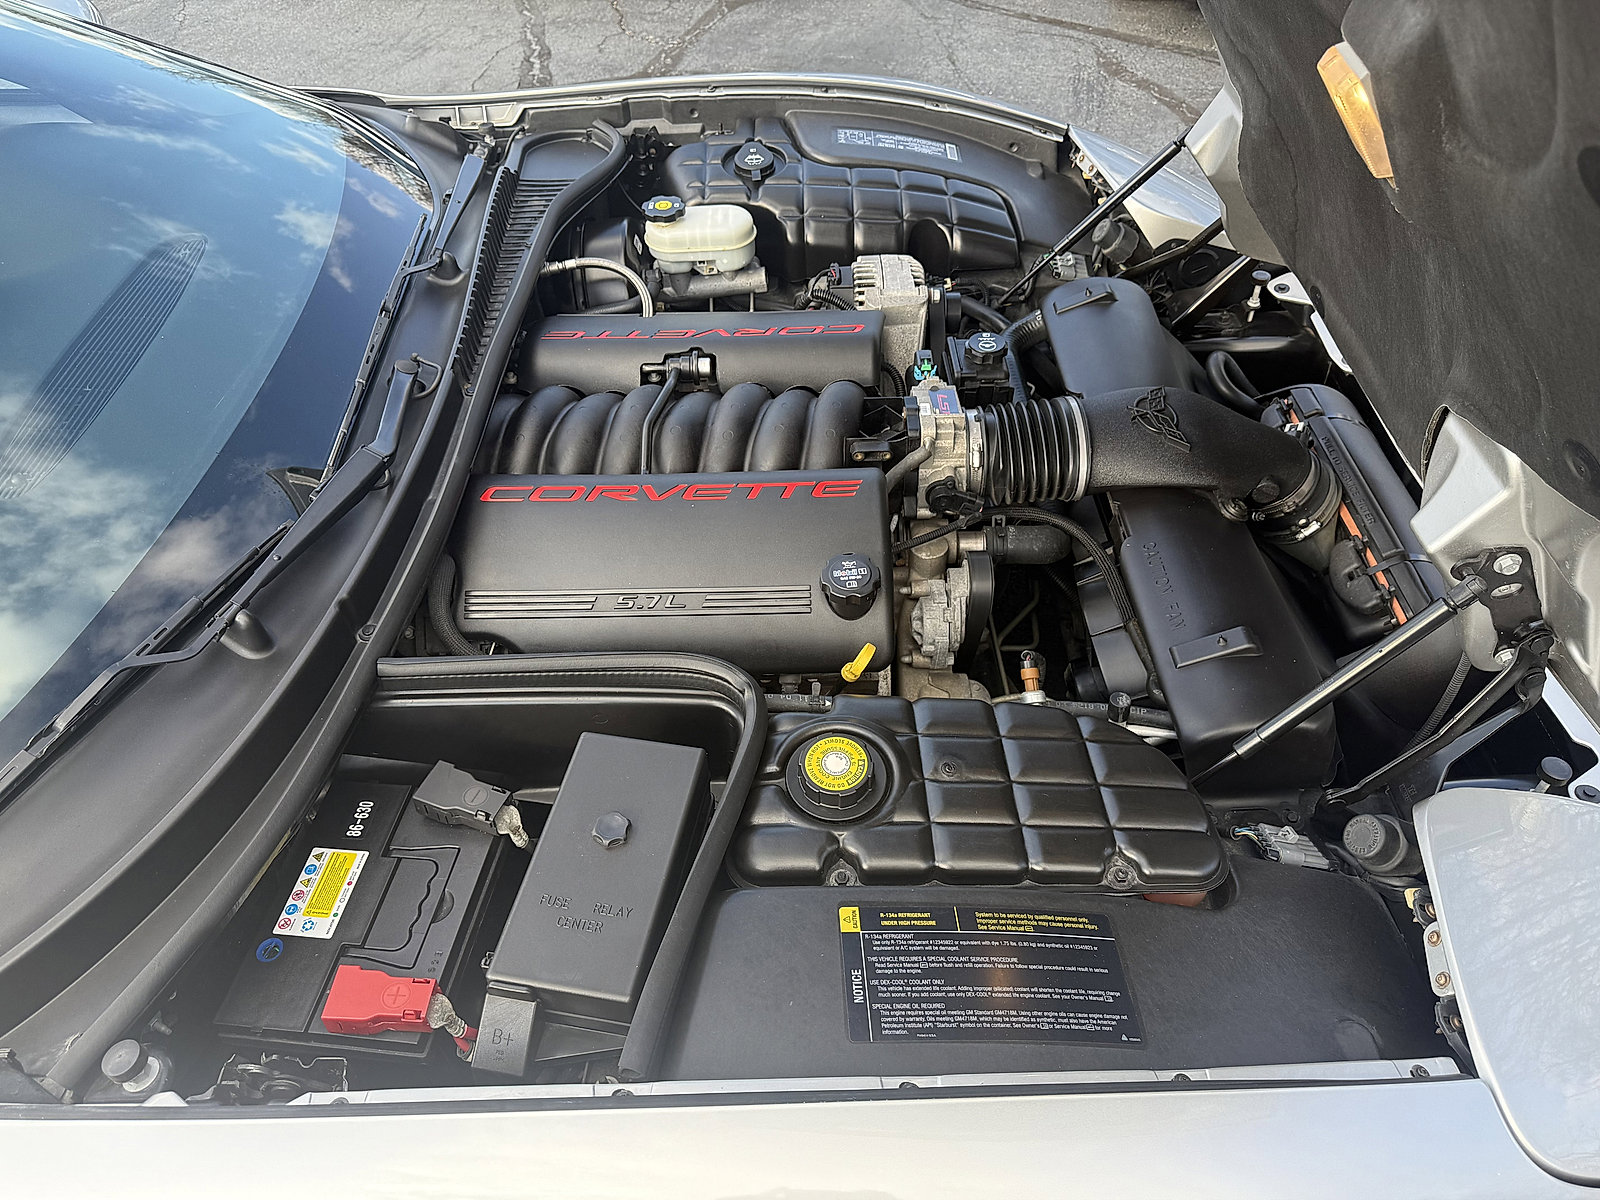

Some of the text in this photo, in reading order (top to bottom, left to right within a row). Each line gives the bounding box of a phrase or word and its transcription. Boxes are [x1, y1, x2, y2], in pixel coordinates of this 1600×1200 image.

[541, 324, 864, 339] CORVETTE
[1322, 436, 1336, 456] PULL
[1340, 467, 1360, 496] SERVICE
[480, 479, 863, 502] CORVETTE
[1142, 542, 1186, 631] CAUTION FAN
[613, 595, 687, 609] 5.7L
[346, 801, 374, 837] 86-630
[540, 894, 634, 918] FUSE RELAY
[556, 915, 604, 933] CENTER
[851, 969, 864, 1003] NOTICE
[492, 1028, 513, 1046] B+
